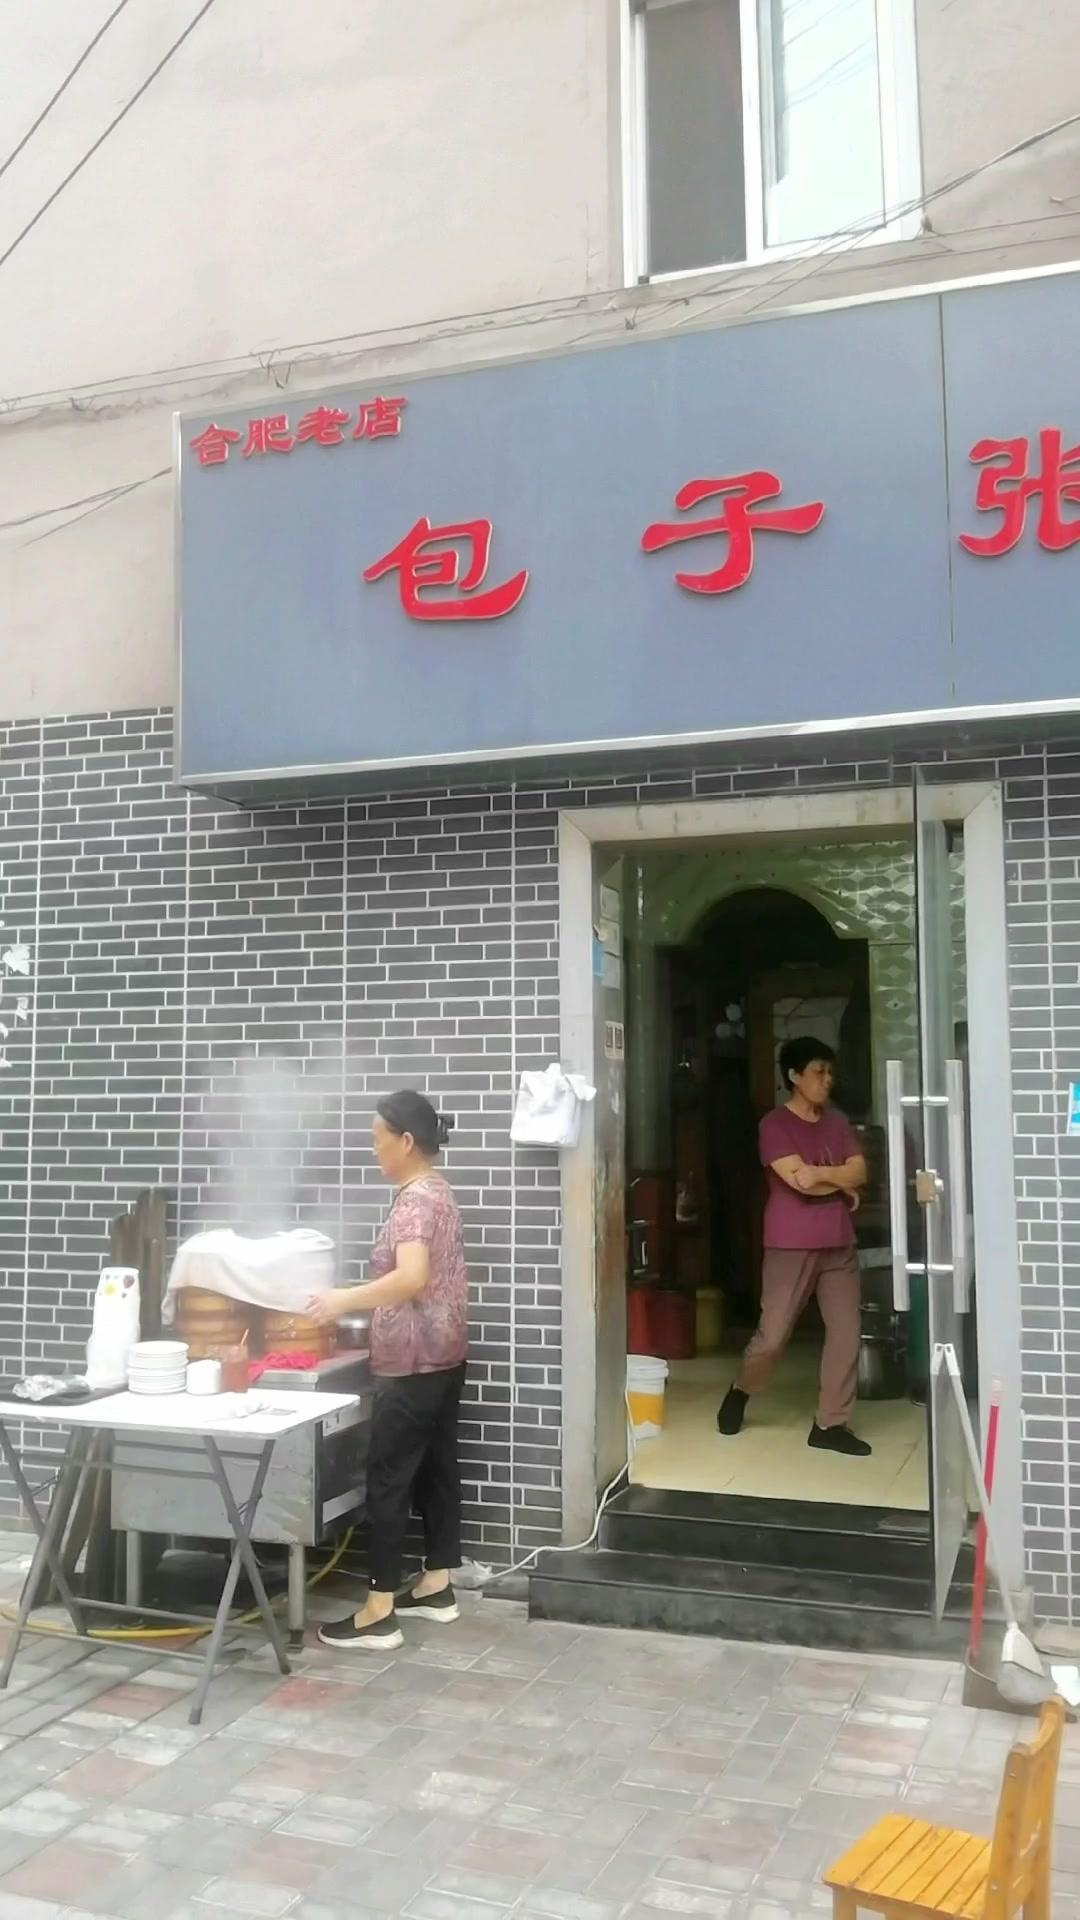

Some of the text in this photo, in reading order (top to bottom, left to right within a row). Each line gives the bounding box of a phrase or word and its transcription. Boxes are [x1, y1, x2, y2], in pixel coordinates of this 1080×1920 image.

[189, 396, 406, 466] 合肥老店
[363, 425, 1080, 621] 包子张
